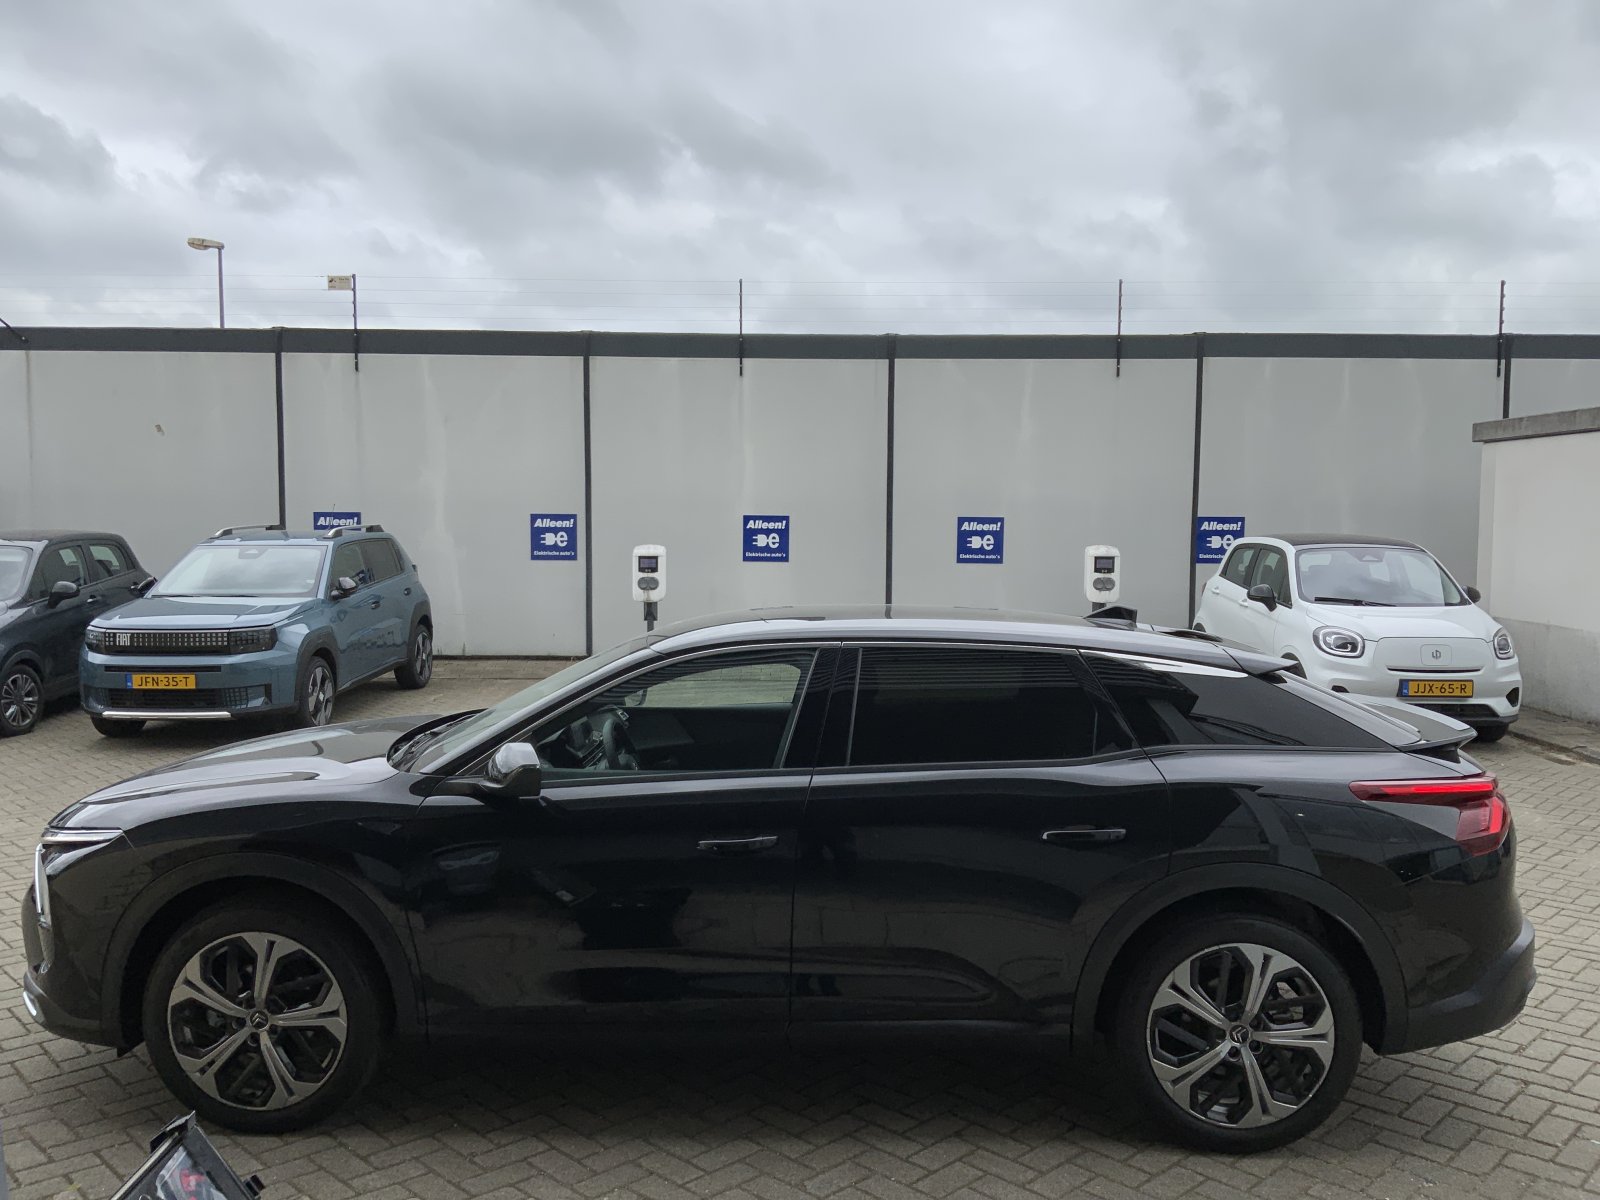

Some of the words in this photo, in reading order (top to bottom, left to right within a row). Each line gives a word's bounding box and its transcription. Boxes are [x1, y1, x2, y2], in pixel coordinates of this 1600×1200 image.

[317, 516, 358, 526] Alleen!
[534, 518, 574, 528] Alleen!
[746, 520, 786, 529] Alleen!
[1200, 522, 1242, 530] Alleen!
[960, 522, 1001, 531] Alleen!
[116, 634, 131, 646] FIAT
[138, 676, 190, 687] JFN-35-T
[1414, 684, 1467, 694] JJX-65-R
